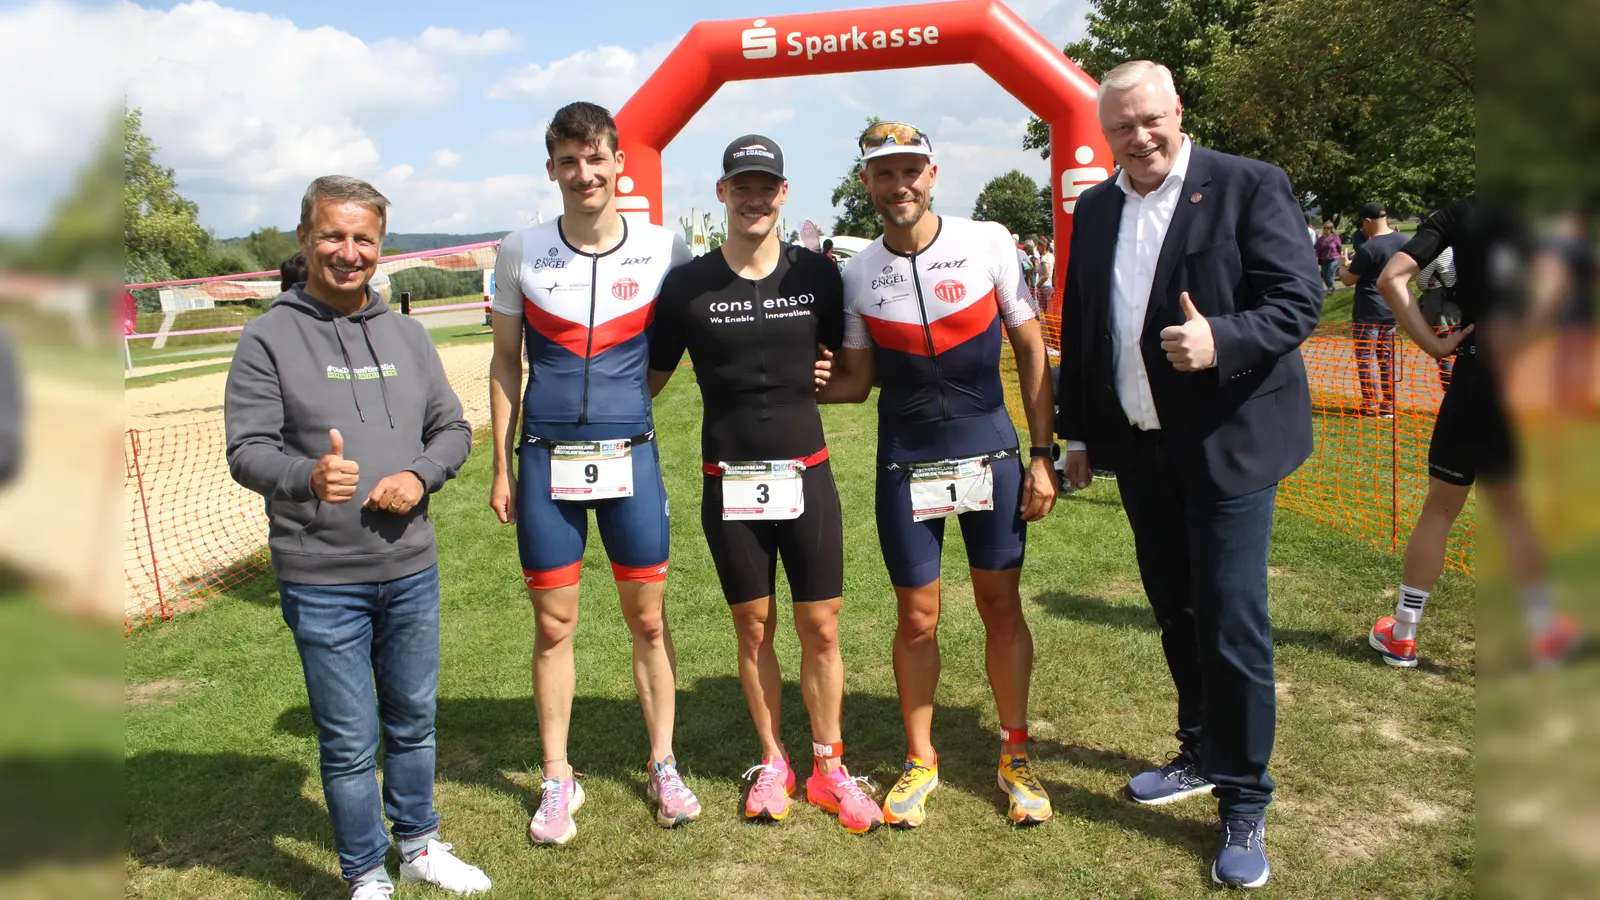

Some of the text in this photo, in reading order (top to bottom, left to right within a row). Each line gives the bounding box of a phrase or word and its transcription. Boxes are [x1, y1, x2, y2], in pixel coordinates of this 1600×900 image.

[786, 26, 939, 60] Sparkasse
[534, 258, 567, 269] ENGEL
[871, 275, 907, 290] ENGEL
[725, 315, 755, 323] Enable
[765, 309, 811, 319] Innovations
[584, 464, 599, 484] 9
[756, 483, 770, 504] 3
[946, 483, 957, 502] 1
